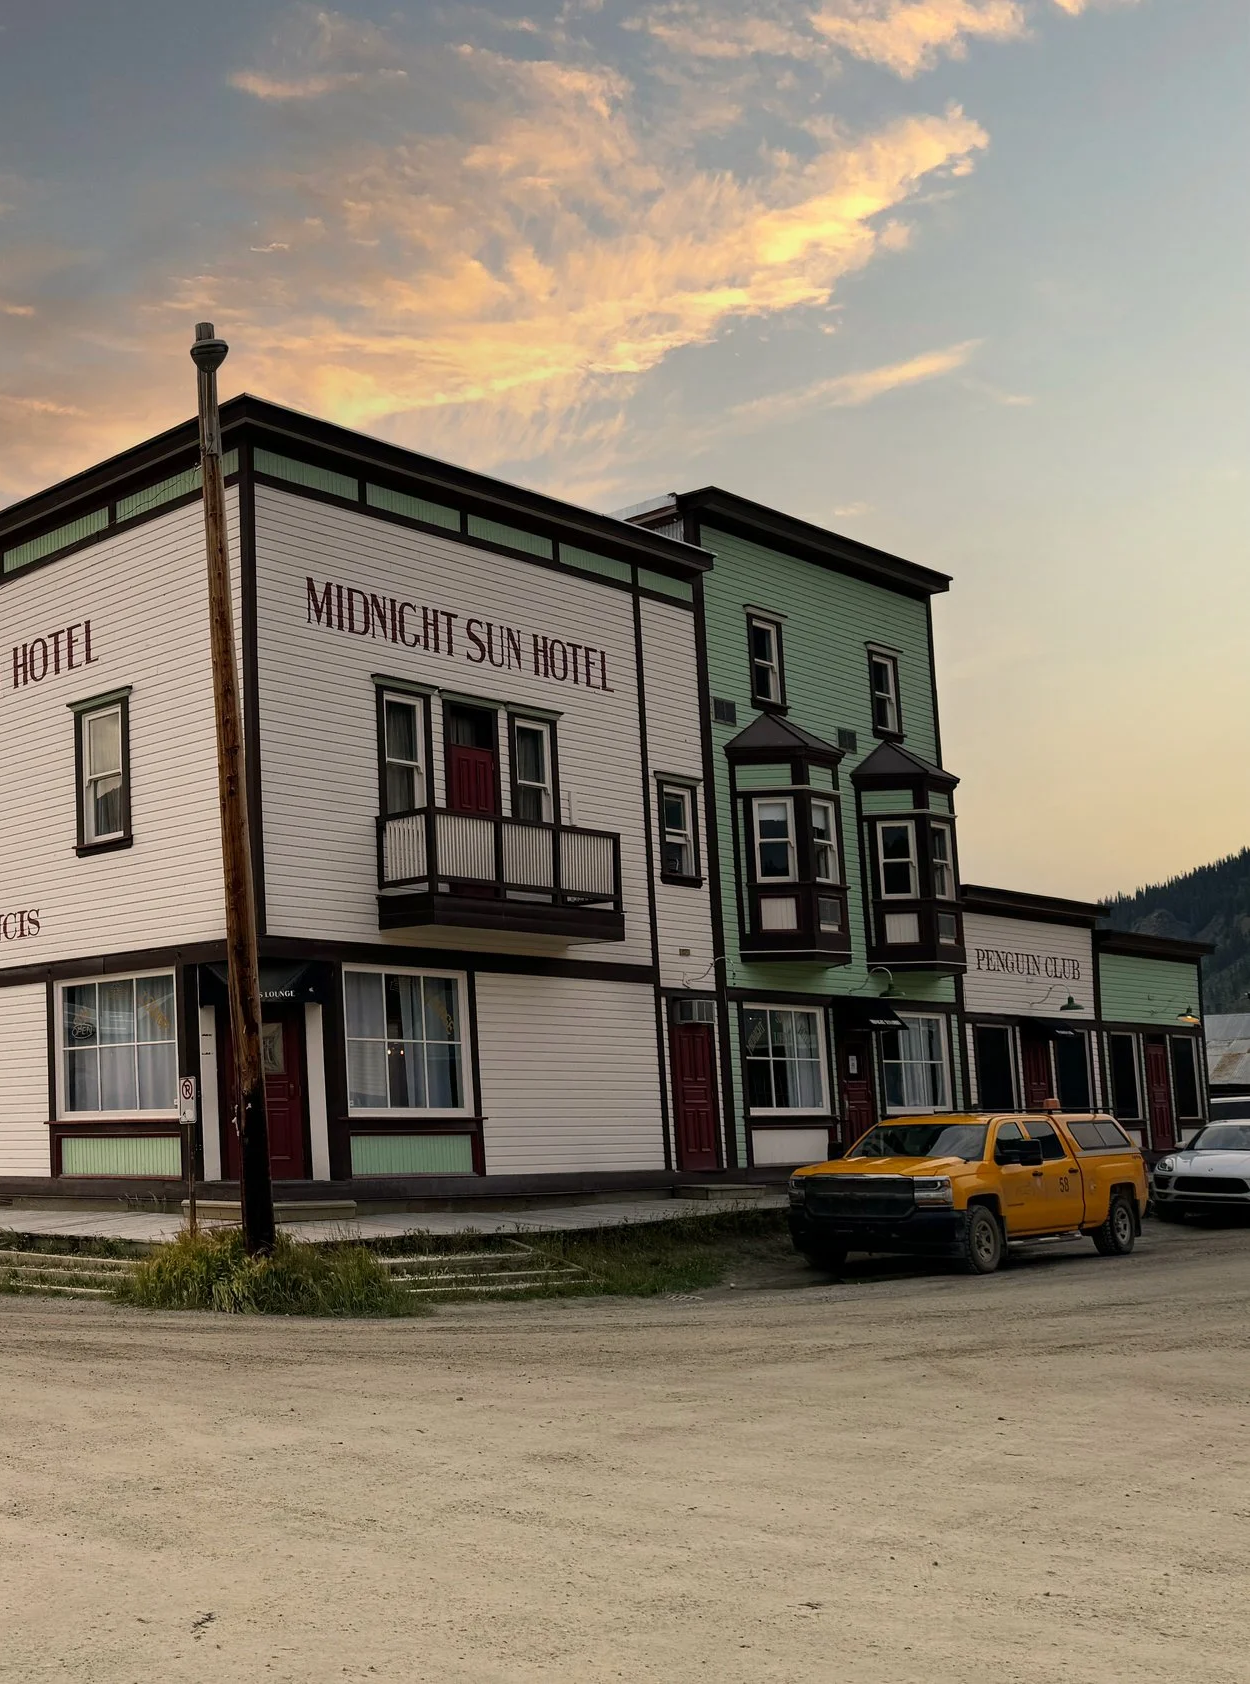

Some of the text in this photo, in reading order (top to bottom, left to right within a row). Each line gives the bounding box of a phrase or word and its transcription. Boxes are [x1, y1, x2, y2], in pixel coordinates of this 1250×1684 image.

[306, 576, 615, 693] MIDNIGHT SUN HOTEL
[12, 619, 99, 689] HOTEL
[975, 948, 1081, 980] PENGUIN CLUB
[264, 989, 296, 999] LOUNGE
[1058, 1176, 1070, 1193] 58
